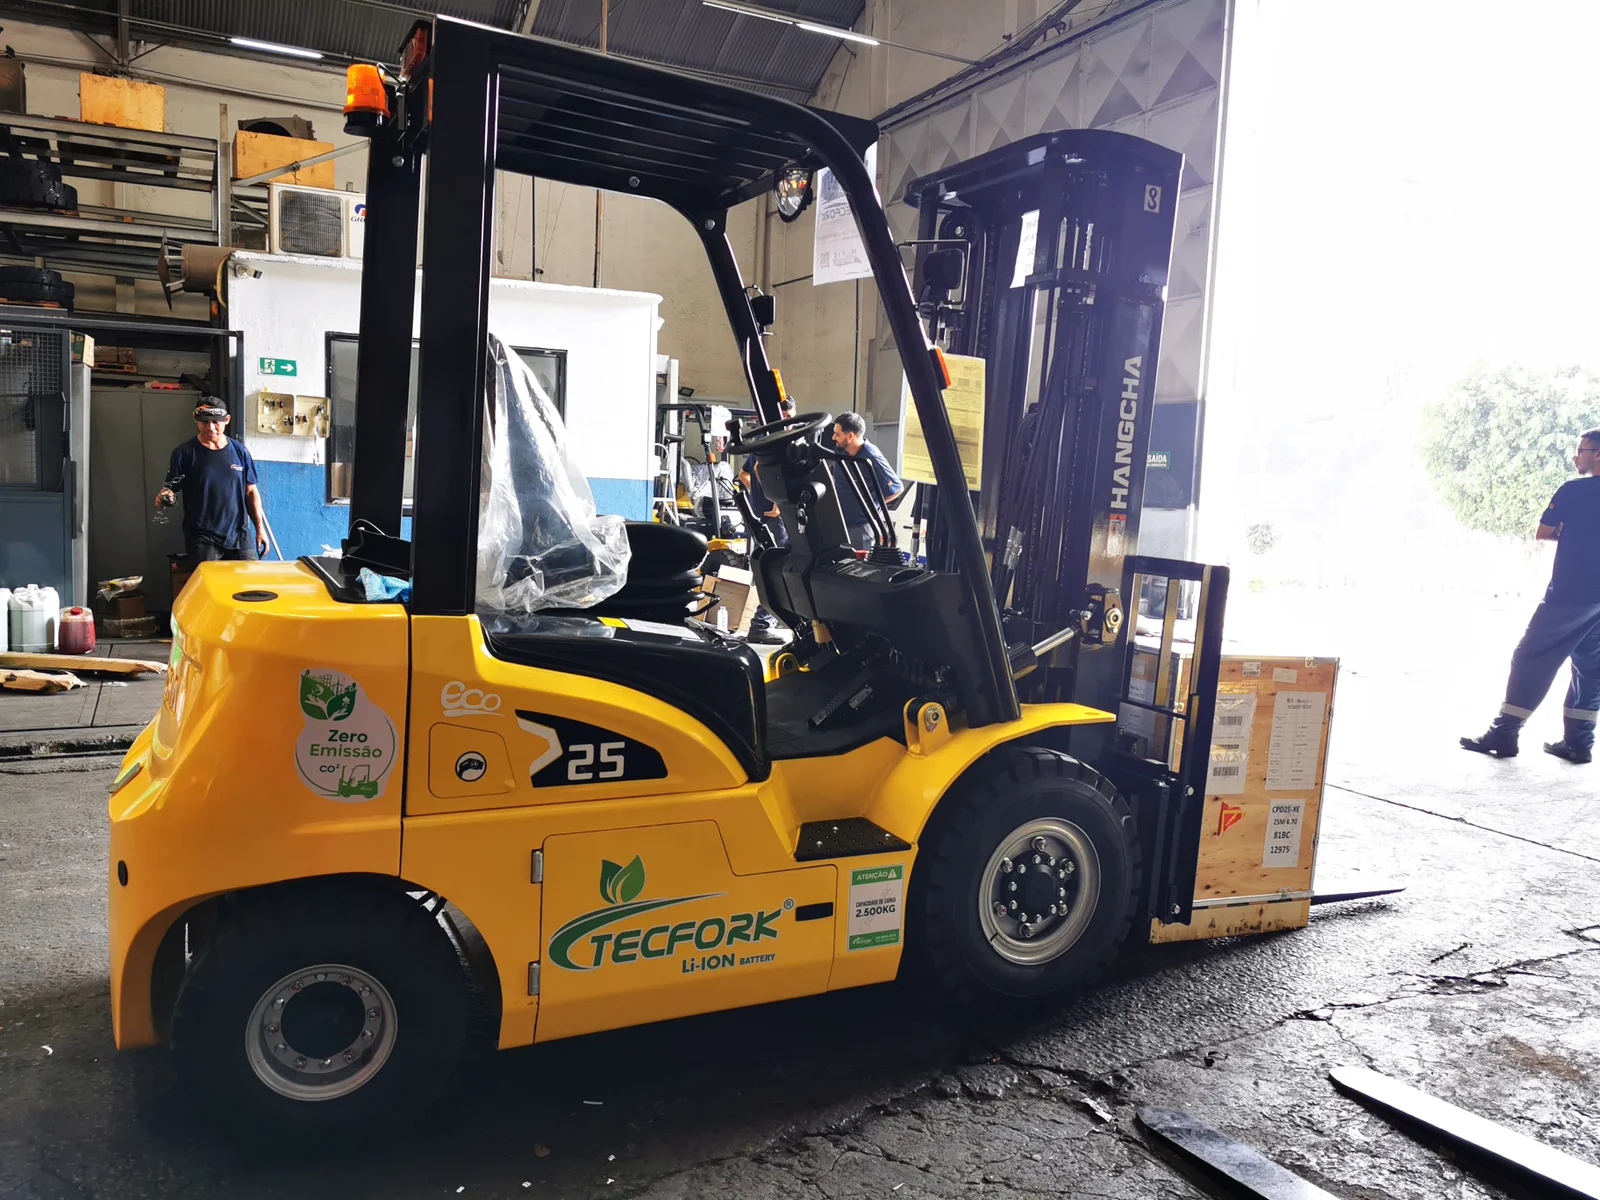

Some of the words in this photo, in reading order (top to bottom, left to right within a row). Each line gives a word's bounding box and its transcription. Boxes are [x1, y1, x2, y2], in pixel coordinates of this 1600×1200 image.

[1110, 355, 1142, 509] HANGCHA
[1147, 453, 1167, 463] SAÍDA
[328, 729, 368, 743] Zero
[309, 743, 383, 758] Emissão
[567, 741, 625, 781] 25
[1272, 805, 1300, 813] CPD25-XE
[1273, 830, 1291, 839] 81BC
[1270, 845, 1290, 854] 12975
[856, 871, 888, 881] ATENÇÃO
[855, 904, 896, 918] 2.500KG
[589, 908, 783, 968] TECFORK
[681, 953, 735, 974] Li-ION
[739, 953, 776, 966] BATTERY
